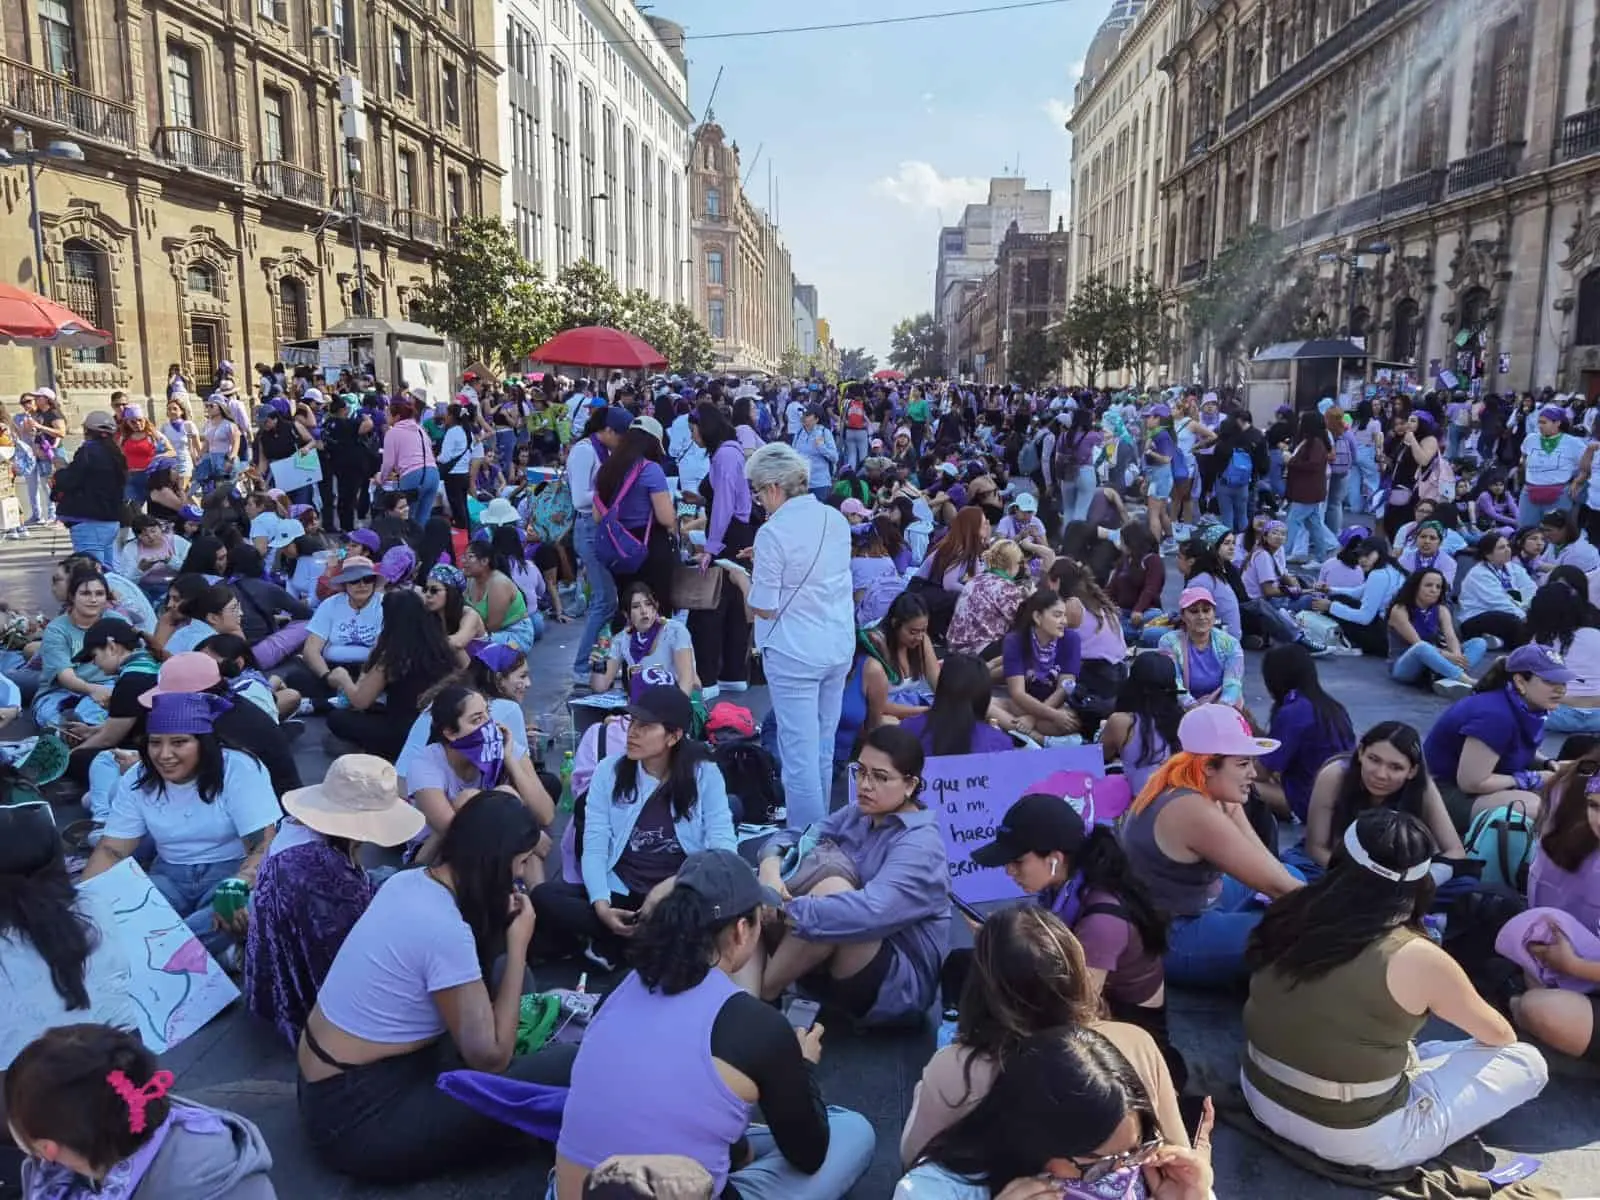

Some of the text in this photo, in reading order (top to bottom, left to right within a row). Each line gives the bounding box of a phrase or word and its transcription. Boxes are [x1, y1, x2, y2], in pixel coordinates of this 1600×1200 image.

[932, 778, 959, 804] que
[966, 775, 991, 790] me
[947, 801, 958, 814] a
